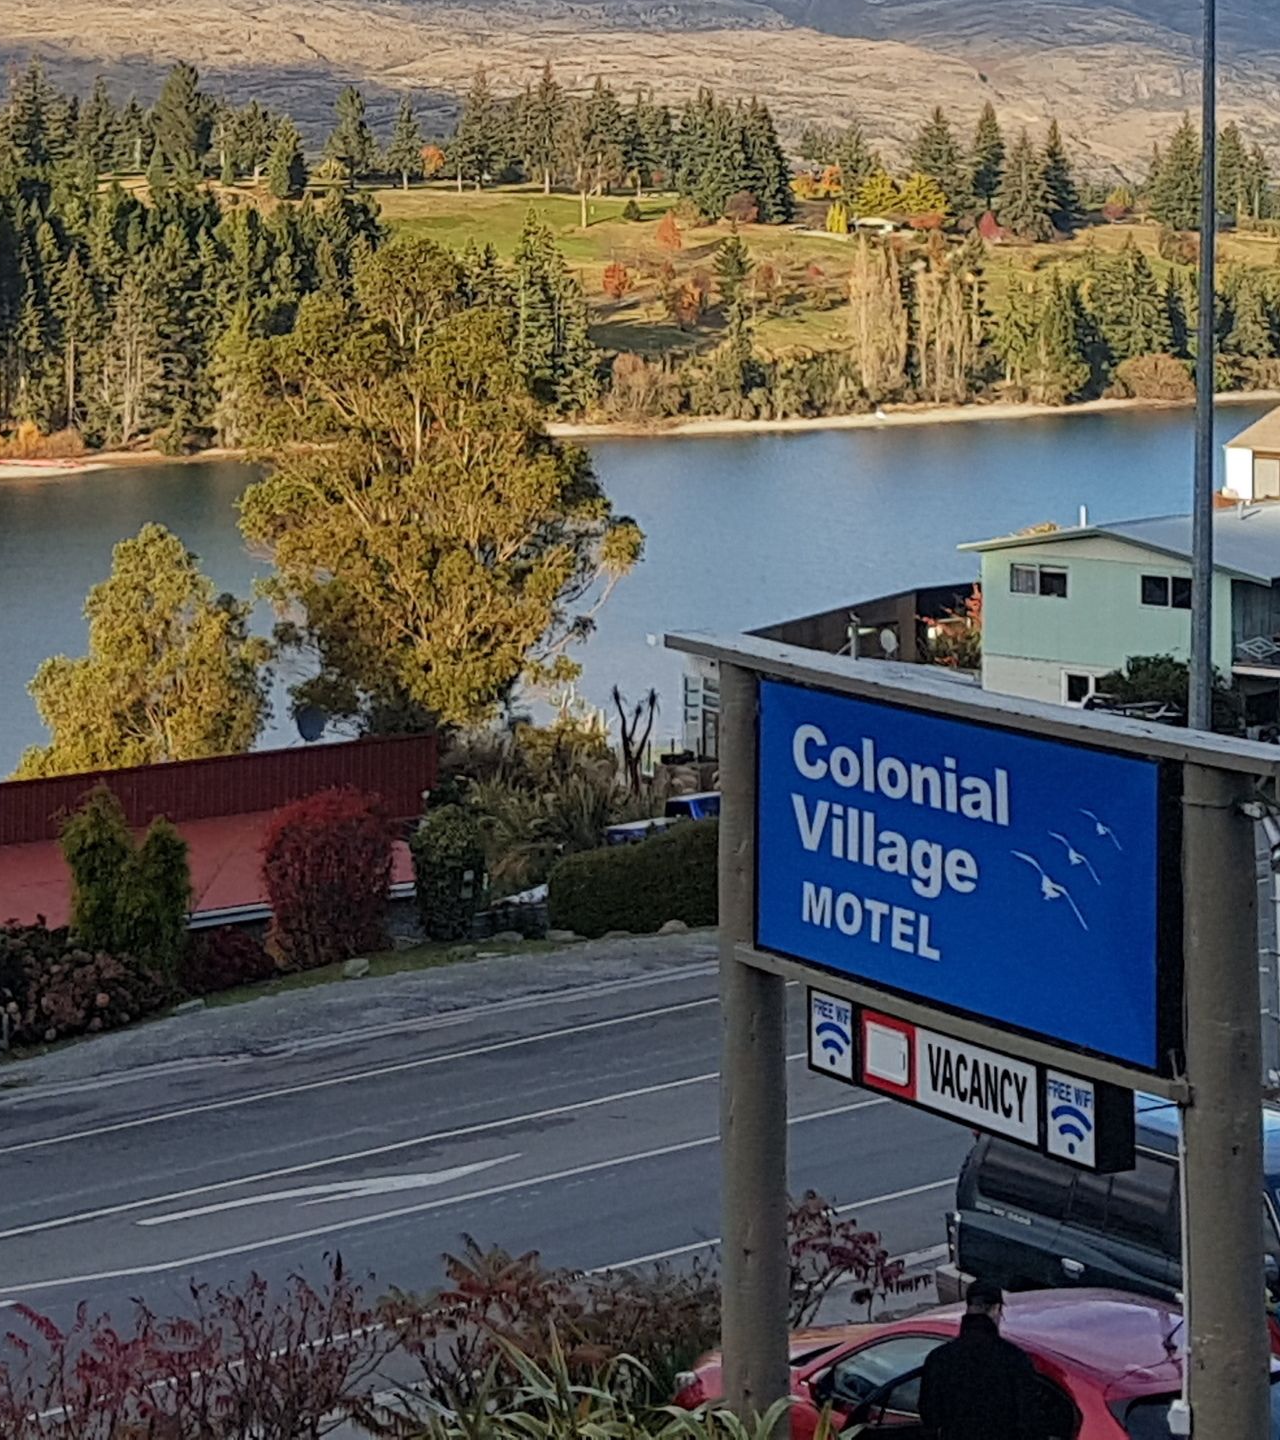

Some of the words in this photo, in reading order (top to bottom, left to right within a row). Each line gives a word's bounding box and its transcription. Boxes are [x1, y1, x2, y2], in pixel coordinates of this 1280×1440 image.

[792, 723, 1010, 827] Colonial
[791, 792, 979, 900] Village
[802, 880, 941, 962] MOTEL
[814, 997, 834, 1020] FREE
[927, 1043, 1028, 1124] VACANCY
[1047, 1079, 1072, 1104] FREE
